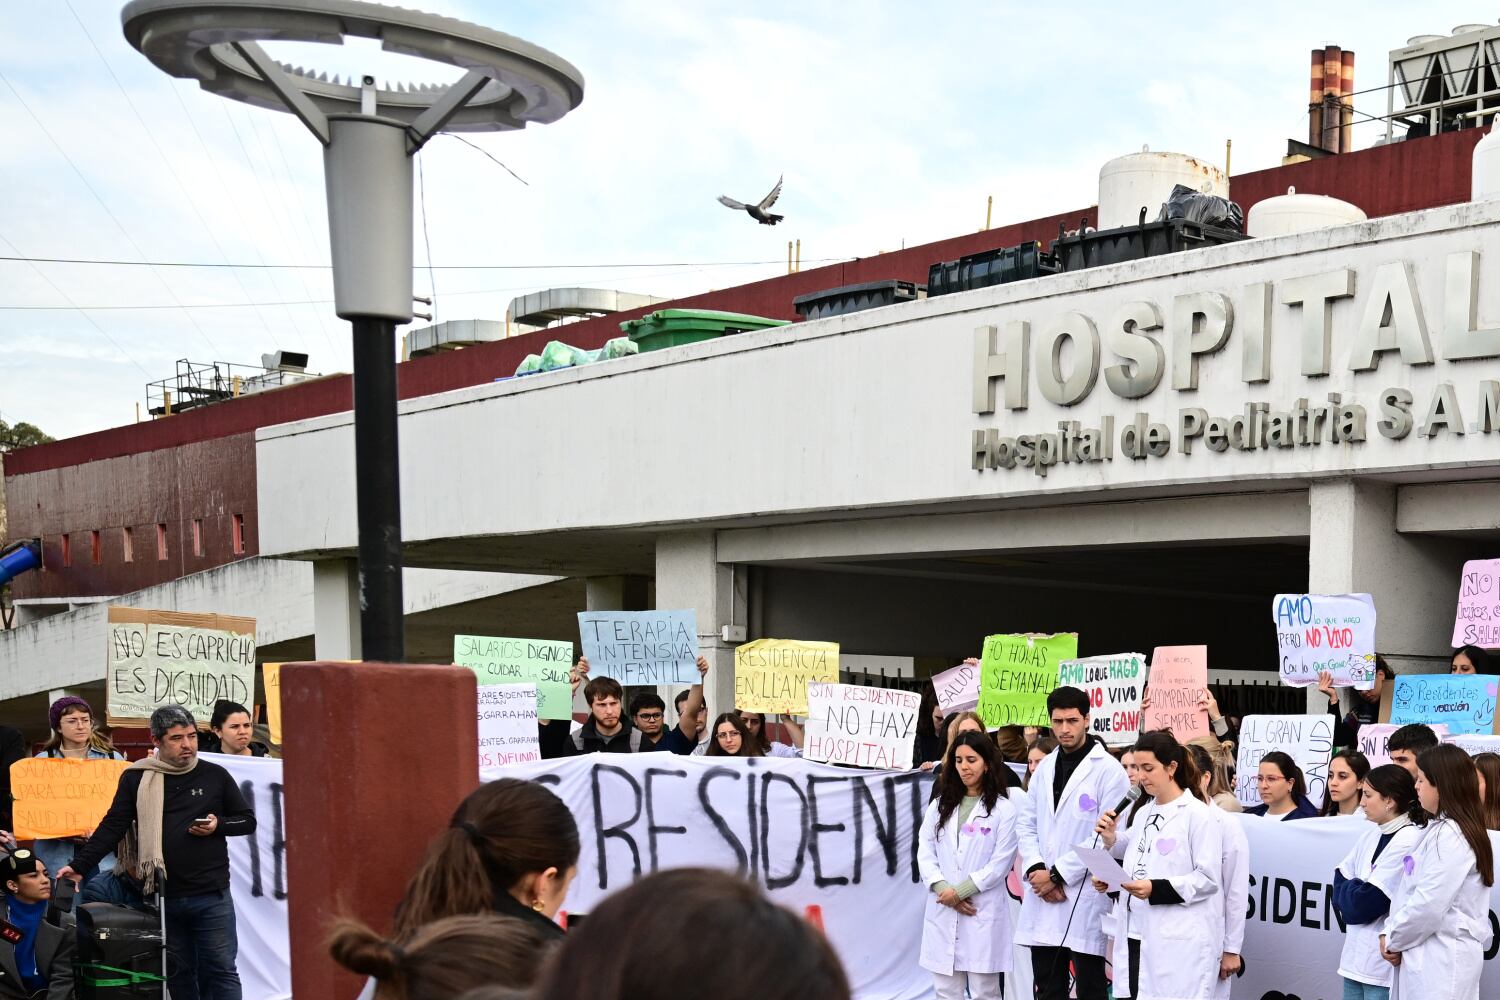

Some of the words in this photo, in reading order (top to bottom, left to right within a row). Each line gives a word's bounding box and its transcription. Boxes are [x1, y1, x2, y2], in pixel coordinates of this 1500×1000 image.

[971, 418, 1114, 477] Hospital
[1120, 411, 1171, 460] de
[1178, 391, 1368, 456] Pediatria
[1463, 573, 1492, 597] NO
[1278, 596, 1313, 627] AMO
[114, 629, 145, 659] NO
[157, 632, 184, 659] ES
[187, 633, 256, 667] CAPRICHO
[1279, 632, 1301, 648] PERO
[1305, 628, 1322, 648] NO
[1323, 626, 1353, 648] VIVO
[598, 643, 695, 661] INTENSIVA
[739, 647, 827, 671] RESIDENCIA
[986, 640, 1003, 661] 70
[488, 662, 522, 677] CUIDAR
[541, 668, 571, 684] SALUD
[607, 660, 692, 684] INFANTIL
[1060, 663, 1084, 686] AMO
[1094, 667, 1108, 681] QUE
[1110, 658, 1139, 679] HAGO
[115, 667, 147, 694] ES
[154, 667, 248, 706] DIGNIDAD
[736, 676, 754, 695] EN
[810, 683, 834, 698] SIN
[844, 687, 918, 709] RESIDENTES
[938, 667, 974, 708] SALUD
[1108, 686, 1137, 702] VIVO
[1417, 680, 1479, 701] Residentes
[826, 706, 860, 735] NO
[869, 709, 914, 739] HAY
[1093, 715, 1111, 732] QUE
[1155, 712, 1200, 731] SIEMPRE
[1243, 719, 1261, 742] AL
[1265, 720, 1302, 743] GRAN
[809, 735, 904, 769] HOSPITAL
[1359, 736, 1377, 757] SIN
[1305, 720, 1333, 799] SALUD
[1246, 873, 1347, 934] SIDEN
